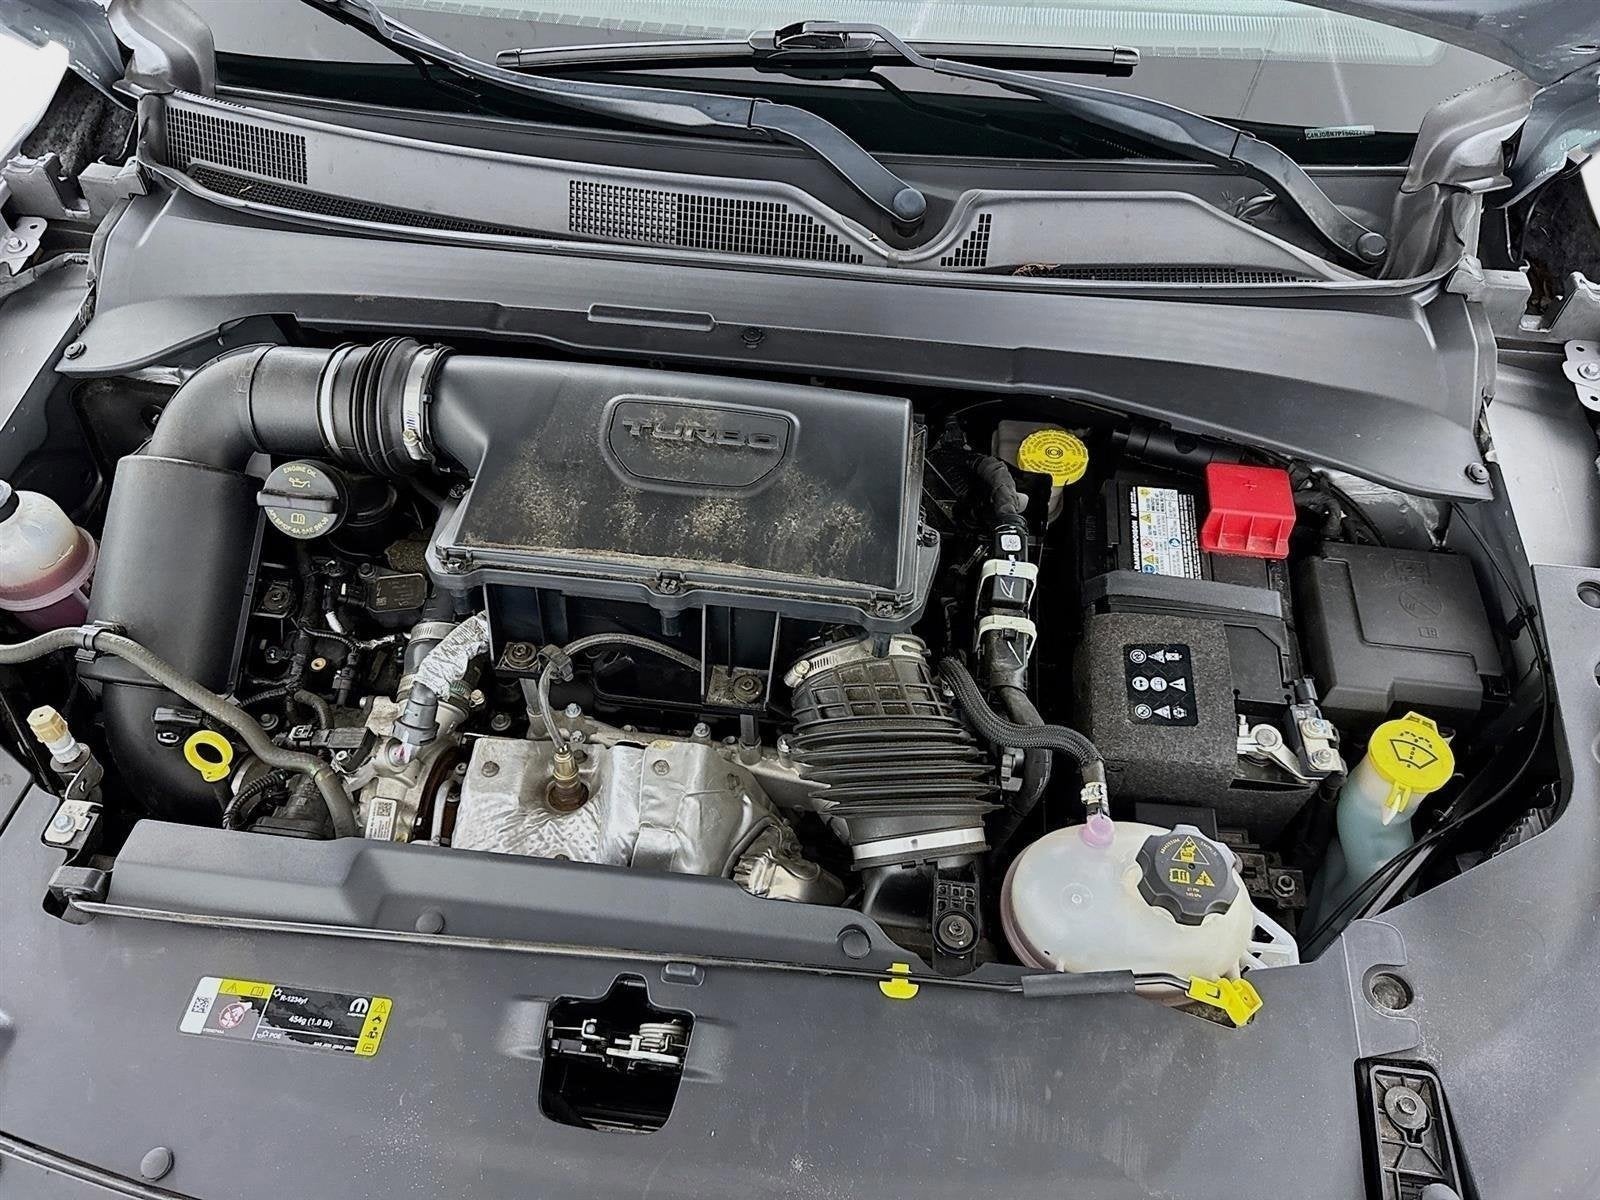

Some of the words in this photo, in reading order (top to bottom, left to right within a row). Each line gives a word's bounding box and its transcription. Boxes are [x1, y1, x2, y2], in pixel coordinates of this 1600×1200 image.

[622, 417, 778, 450] TURBO
[283, 465, 306, 474] ENGINE
[307, 469, 317, 478] OIL
[280, 994, 308, 1005] R-1234yf
[288, 1015, 306, 1025] 454g
[307, 1017, 321, 1027] (1.0
[322, 1019, 333, 1029] lb)
